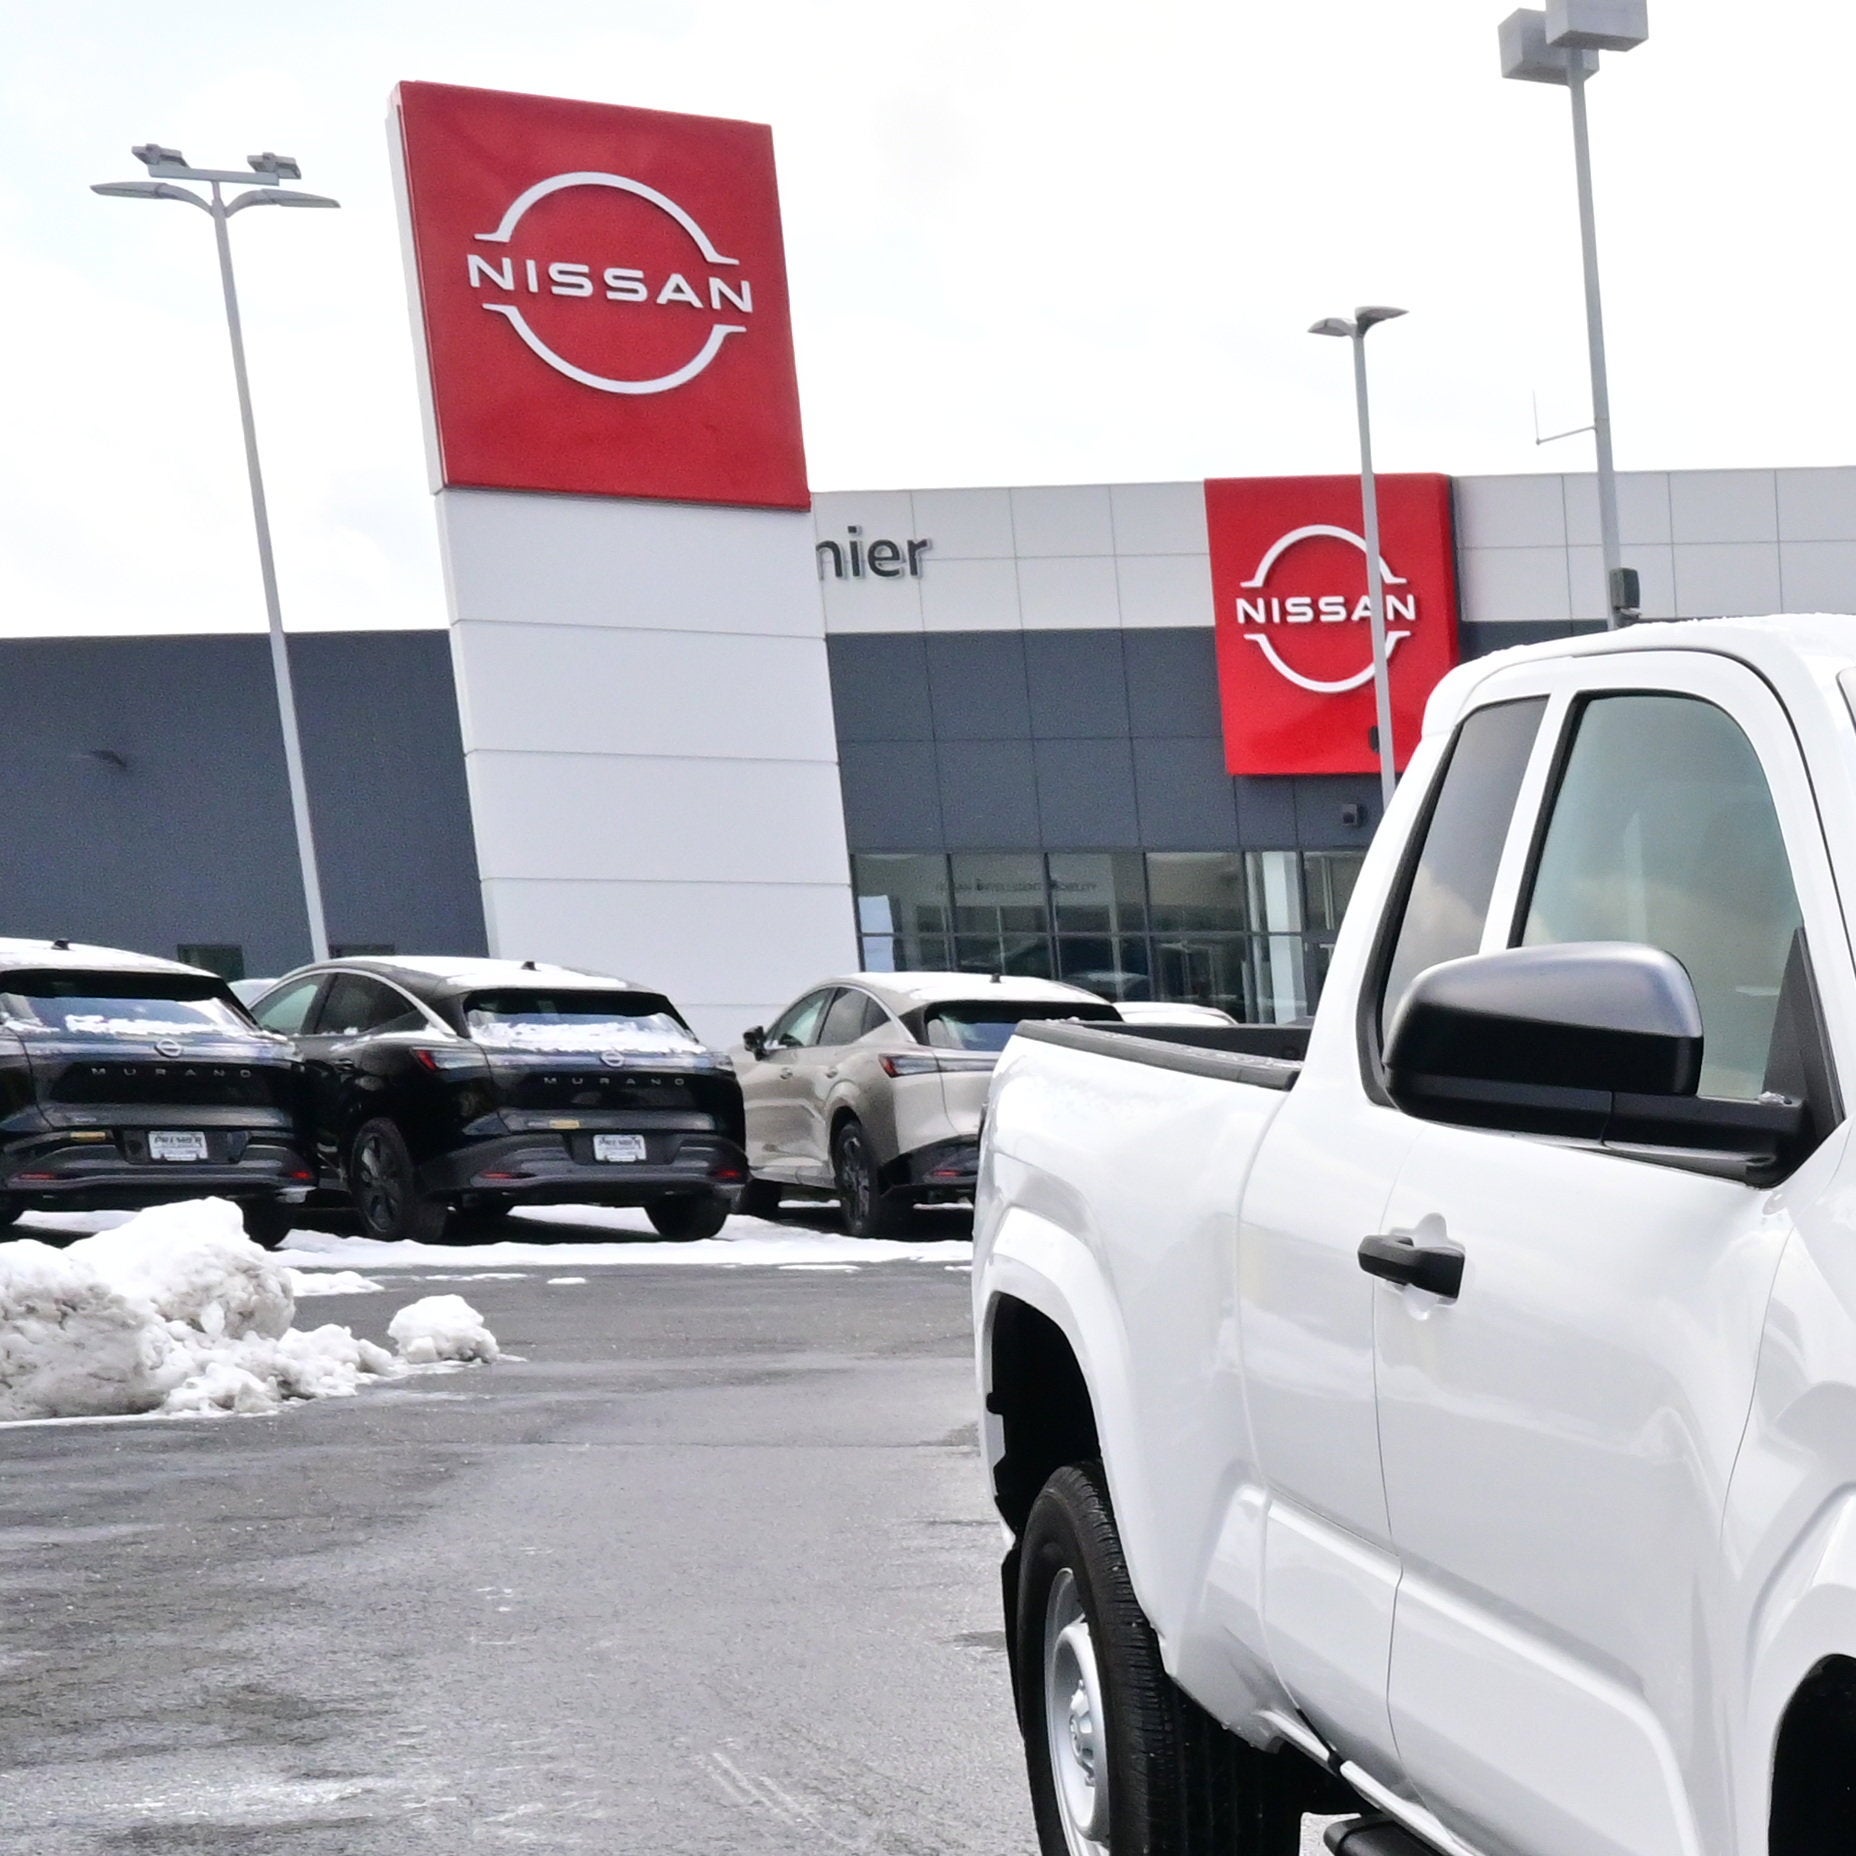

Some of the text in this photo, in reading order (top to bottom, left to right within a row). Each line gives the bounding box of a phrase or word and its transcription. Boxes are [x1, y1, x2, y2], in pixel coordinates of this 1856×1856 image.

[467, 254, 753, 313] NISSAN
[1235, 594, 1416, 624] NISSAN
[91, 1067, 252, 1078] MURANO
[543, 1077, 685, 1086] MURANO
